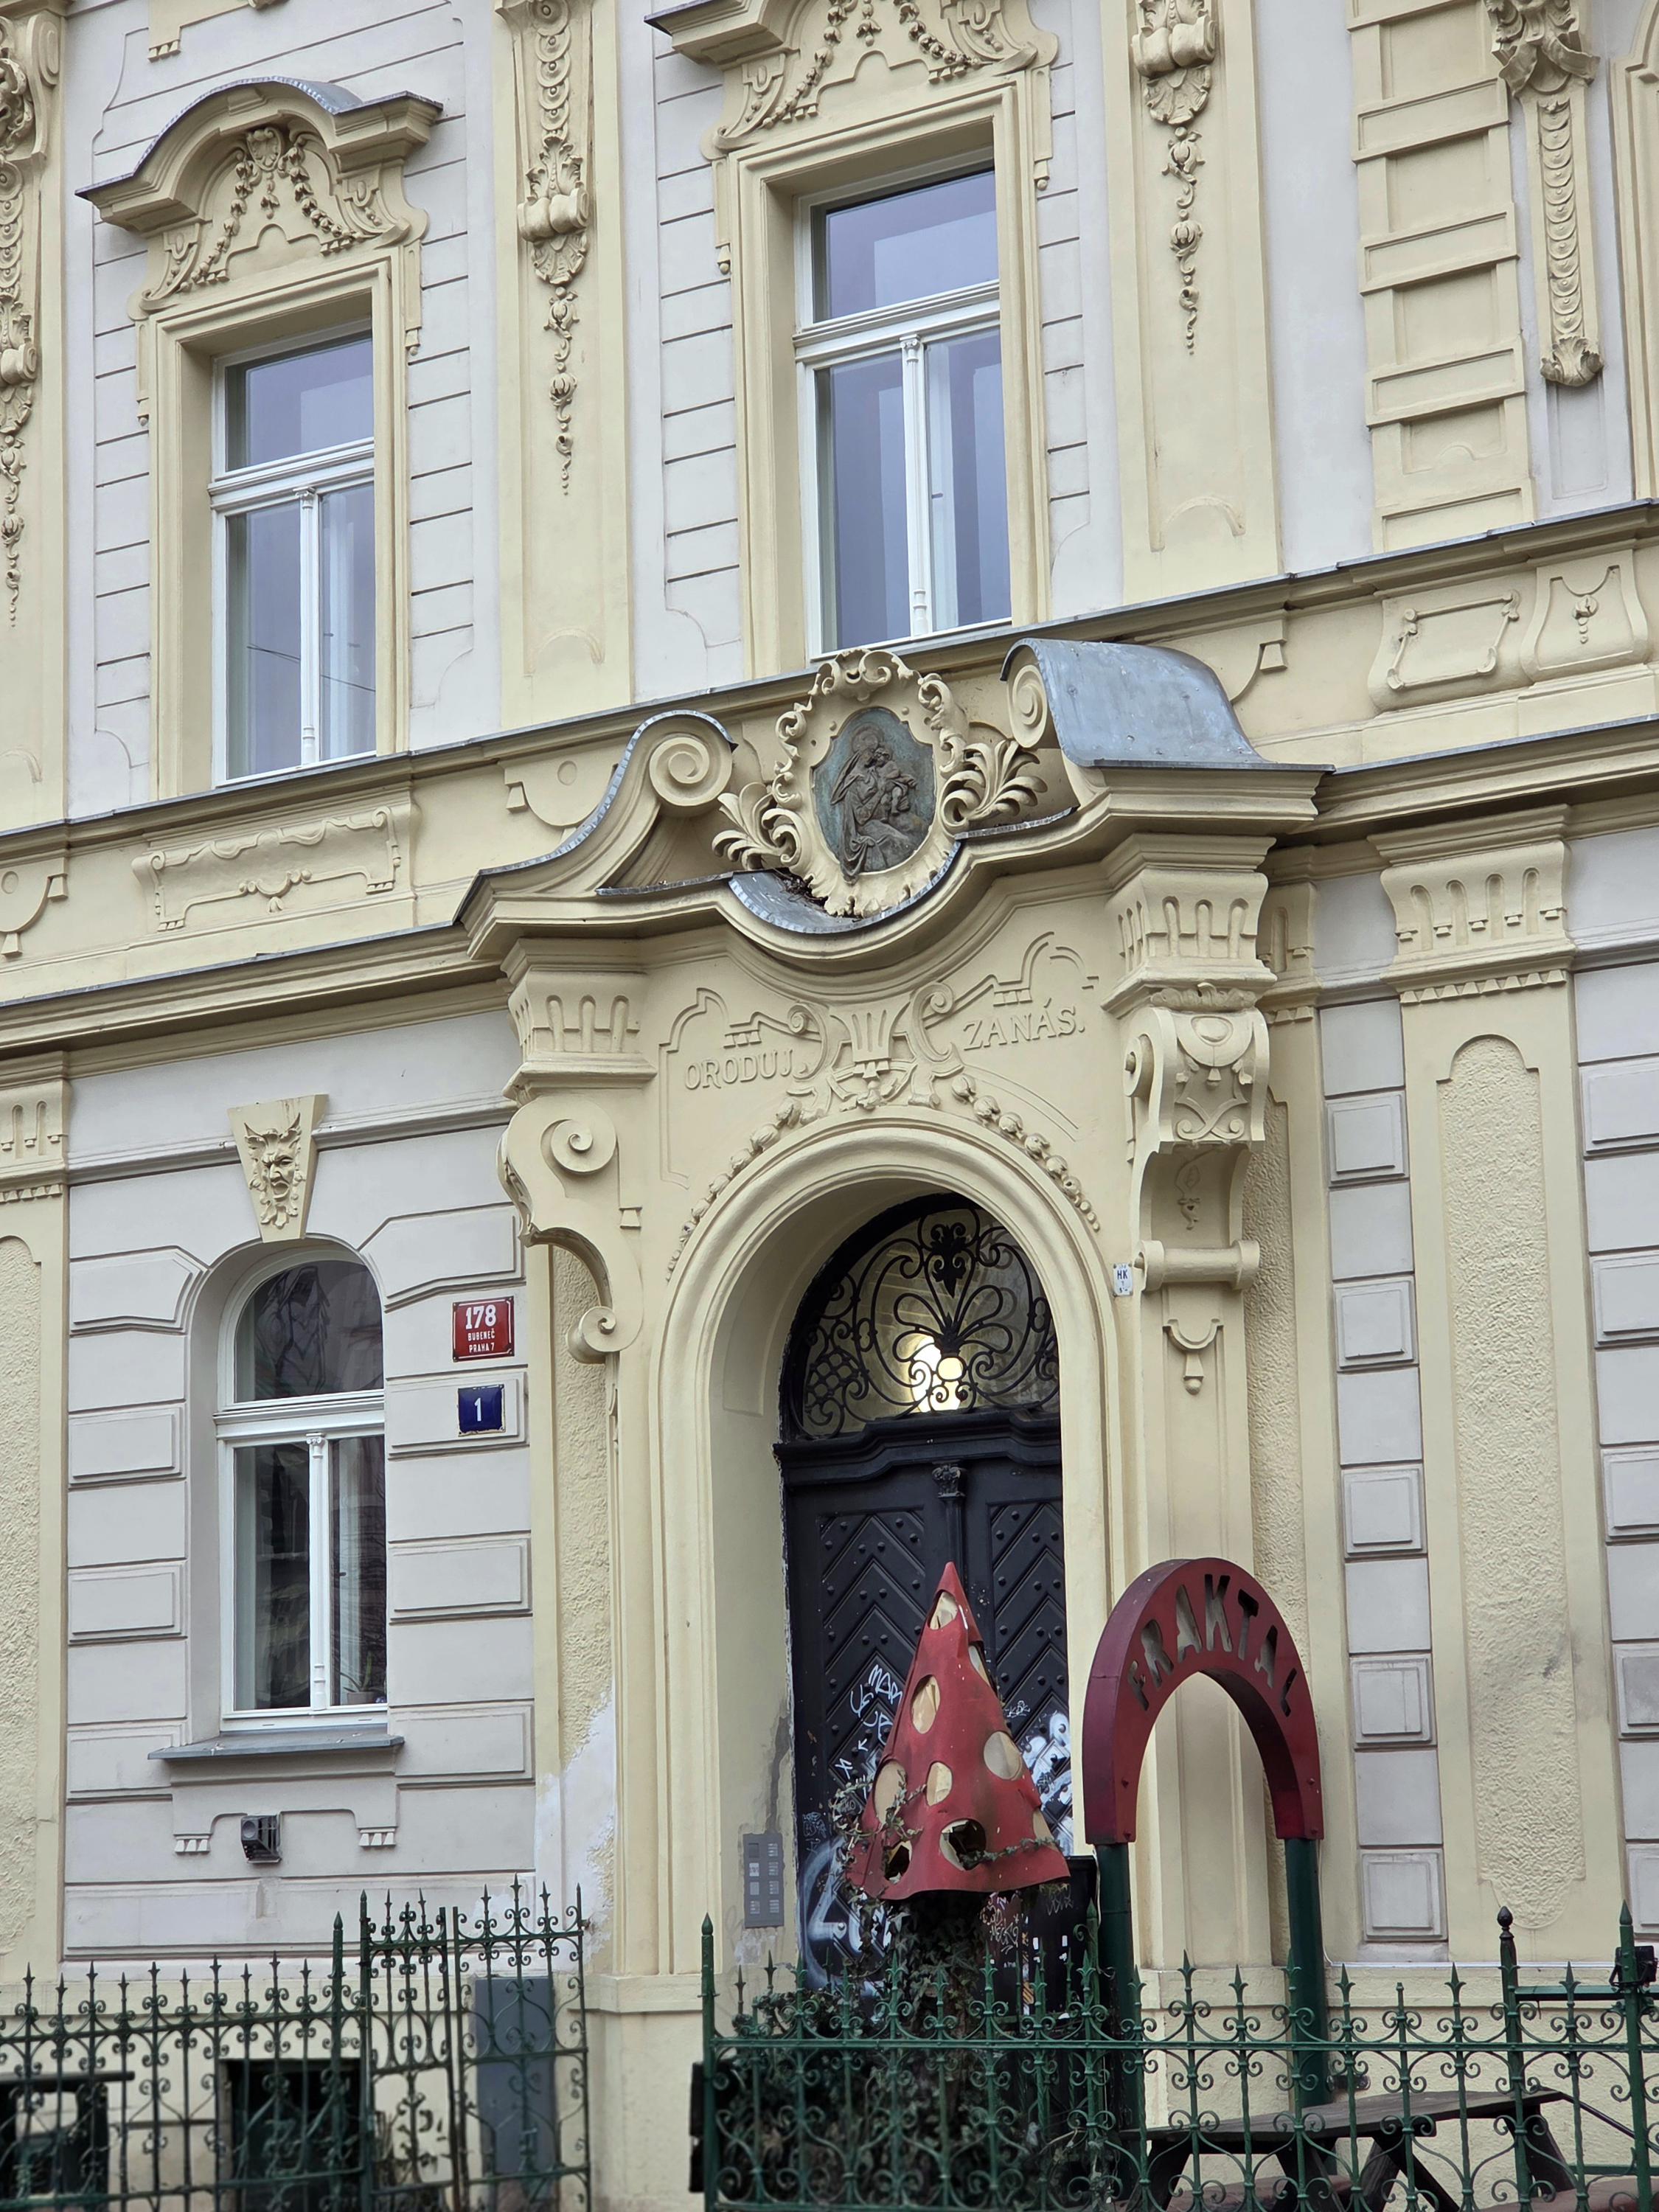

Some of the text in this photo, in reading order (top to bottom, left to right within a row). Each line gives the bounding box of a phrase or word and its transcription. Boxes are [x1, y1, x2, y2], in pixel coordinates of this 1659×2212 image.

[685, 1049, 793, 1091] ORODUJ
[1117, 1269, 1128, 1280] HK
[465, 1304, 496, 1329] 178
[469, 1342, 495, 1353] PRAHA 7
[474, 1397, 482, 1422] 1
[1127, 1573, 1297, 1717] FRAKTAL
